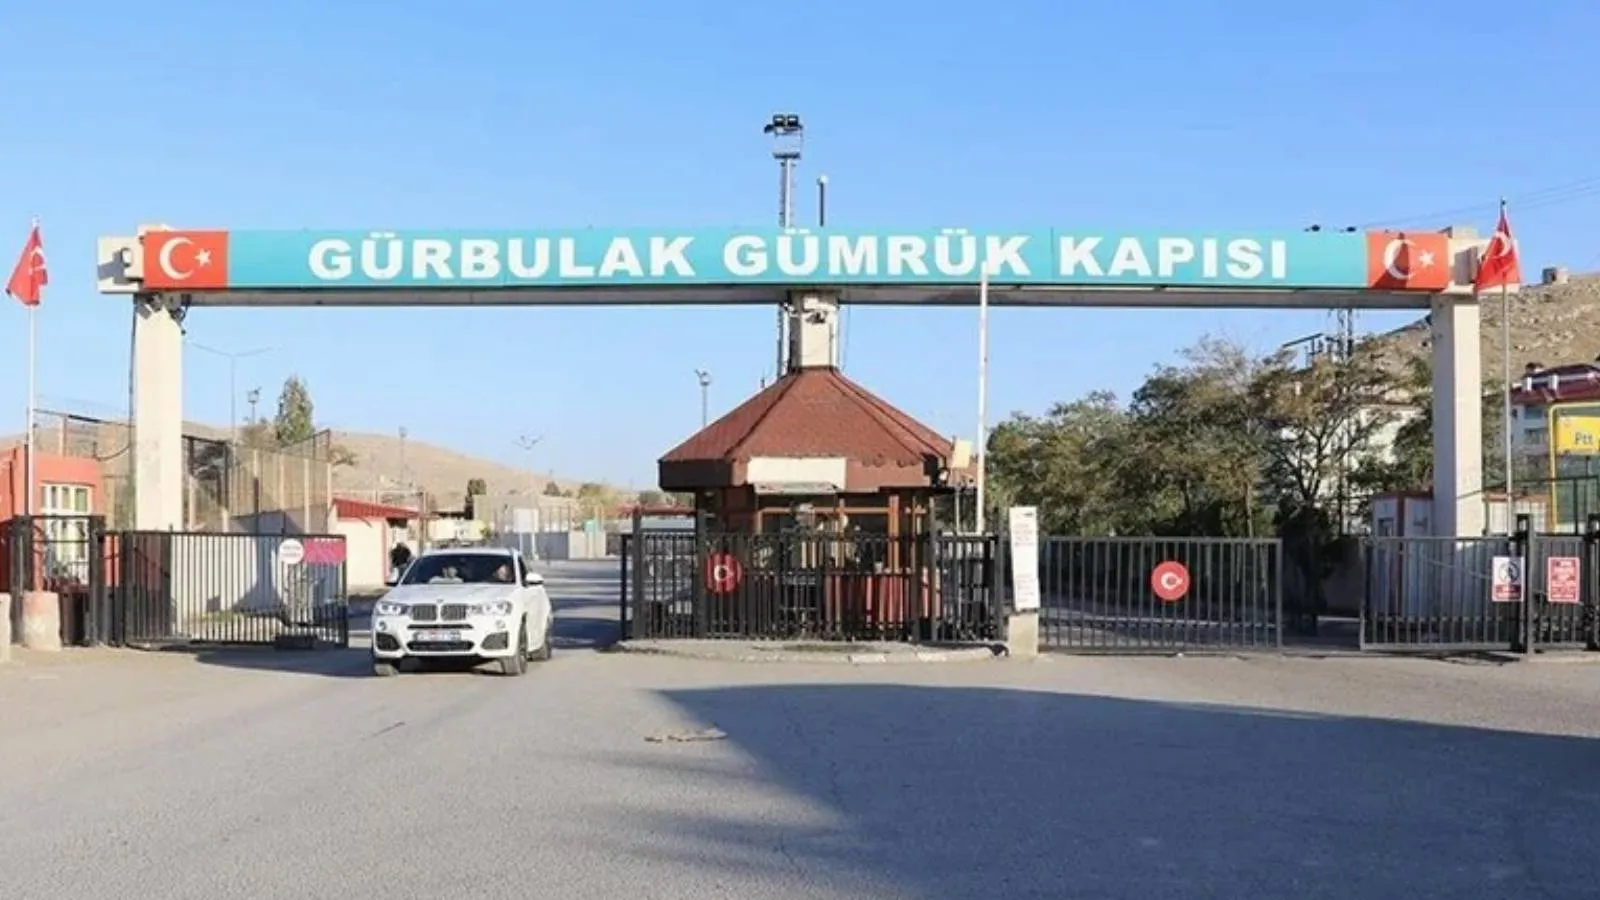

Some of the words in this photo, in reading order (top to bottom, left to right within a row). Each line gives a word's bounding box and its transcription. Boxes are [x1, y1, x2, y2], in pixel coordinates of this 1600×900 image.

[309, 230, 695, 280] GÜRBULAK
[723, 228, 1030, 277] GÜMRÜK
[1060, 236, 1288, 279] KAPISI
